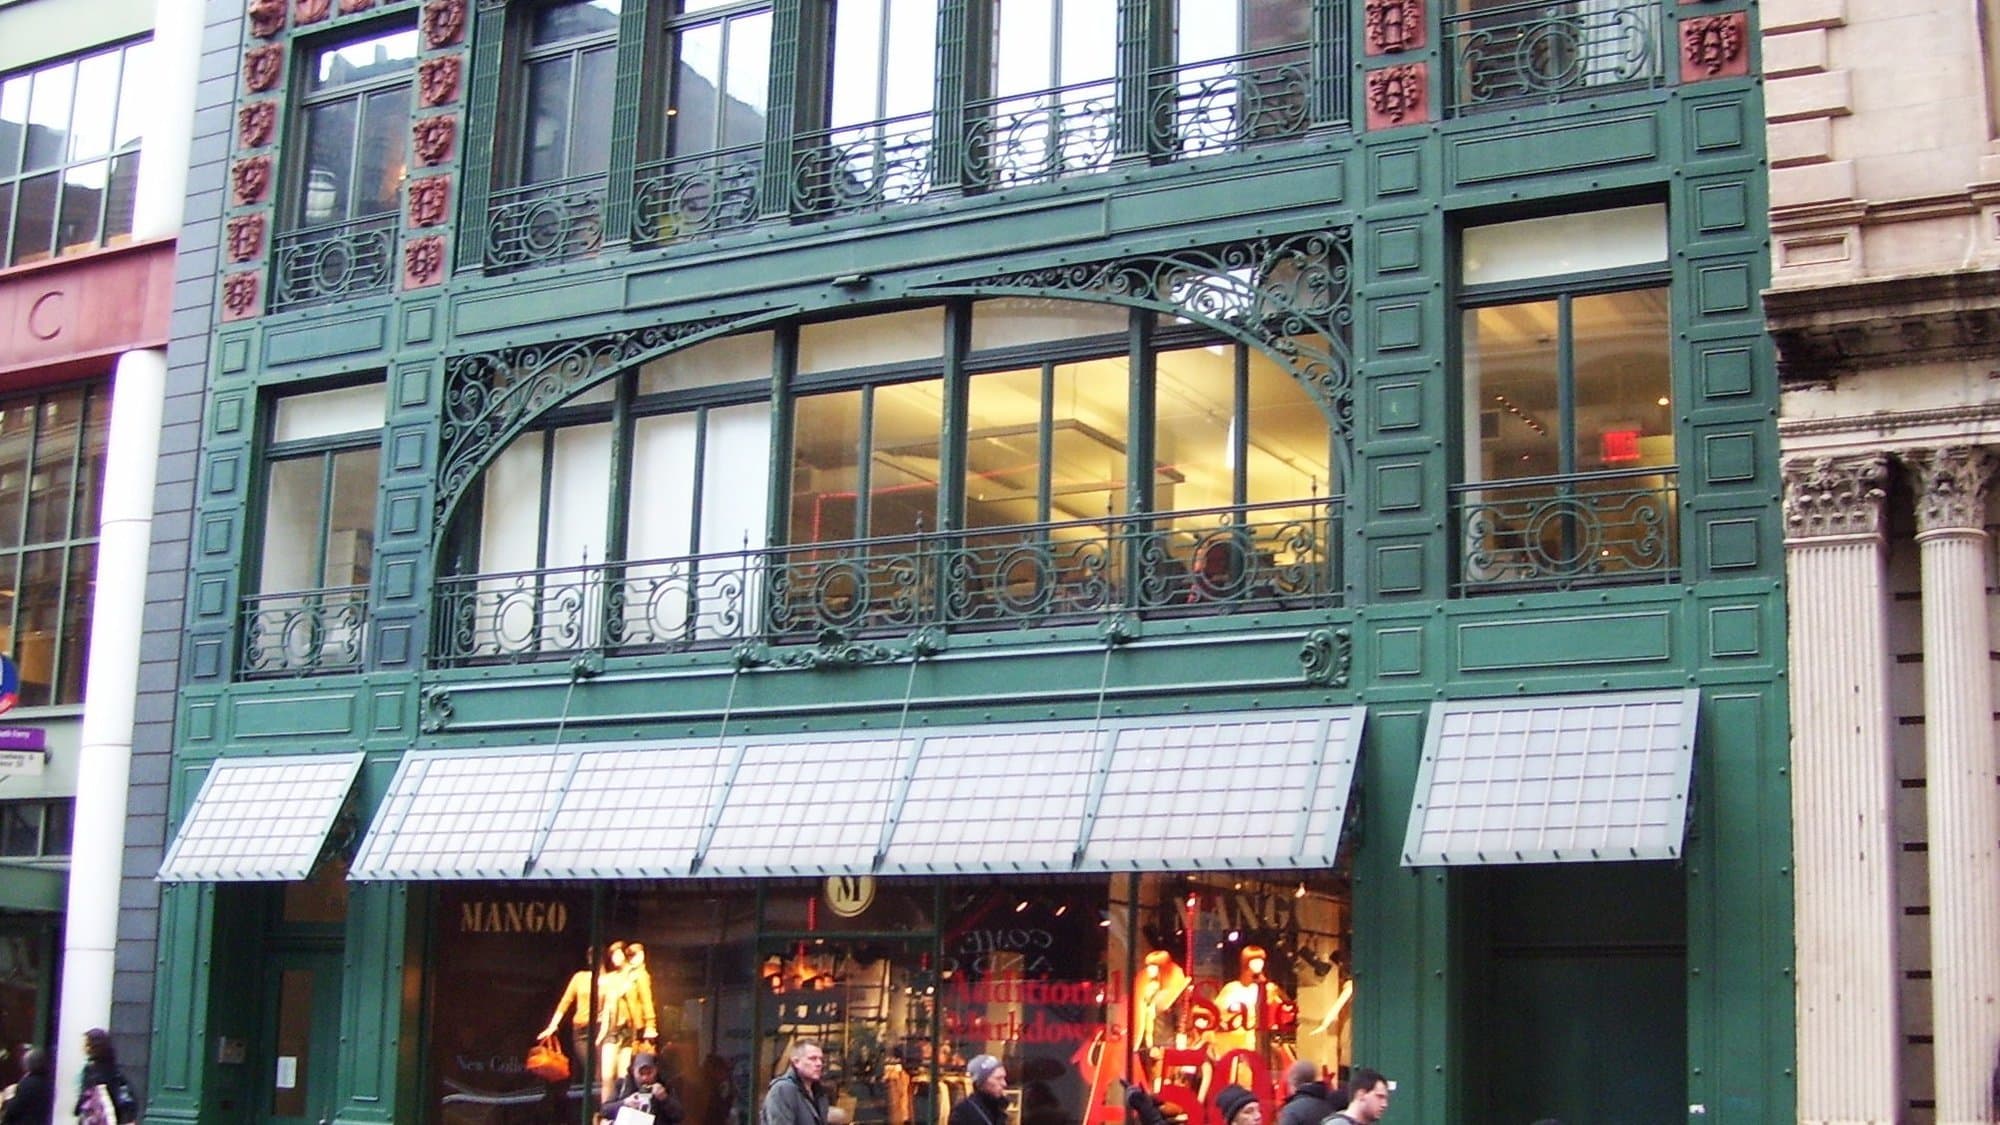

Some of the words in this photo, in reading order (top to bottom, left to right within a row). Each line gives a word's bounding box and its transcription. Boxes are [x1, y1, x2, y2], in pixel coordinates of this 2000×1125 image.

[837, 876, 861, 902] M
[460, 901, 568, 933] MANGO
[1174, 894, 1312, 930] MANG
[1190, 978, 1298, 1033] Sale
